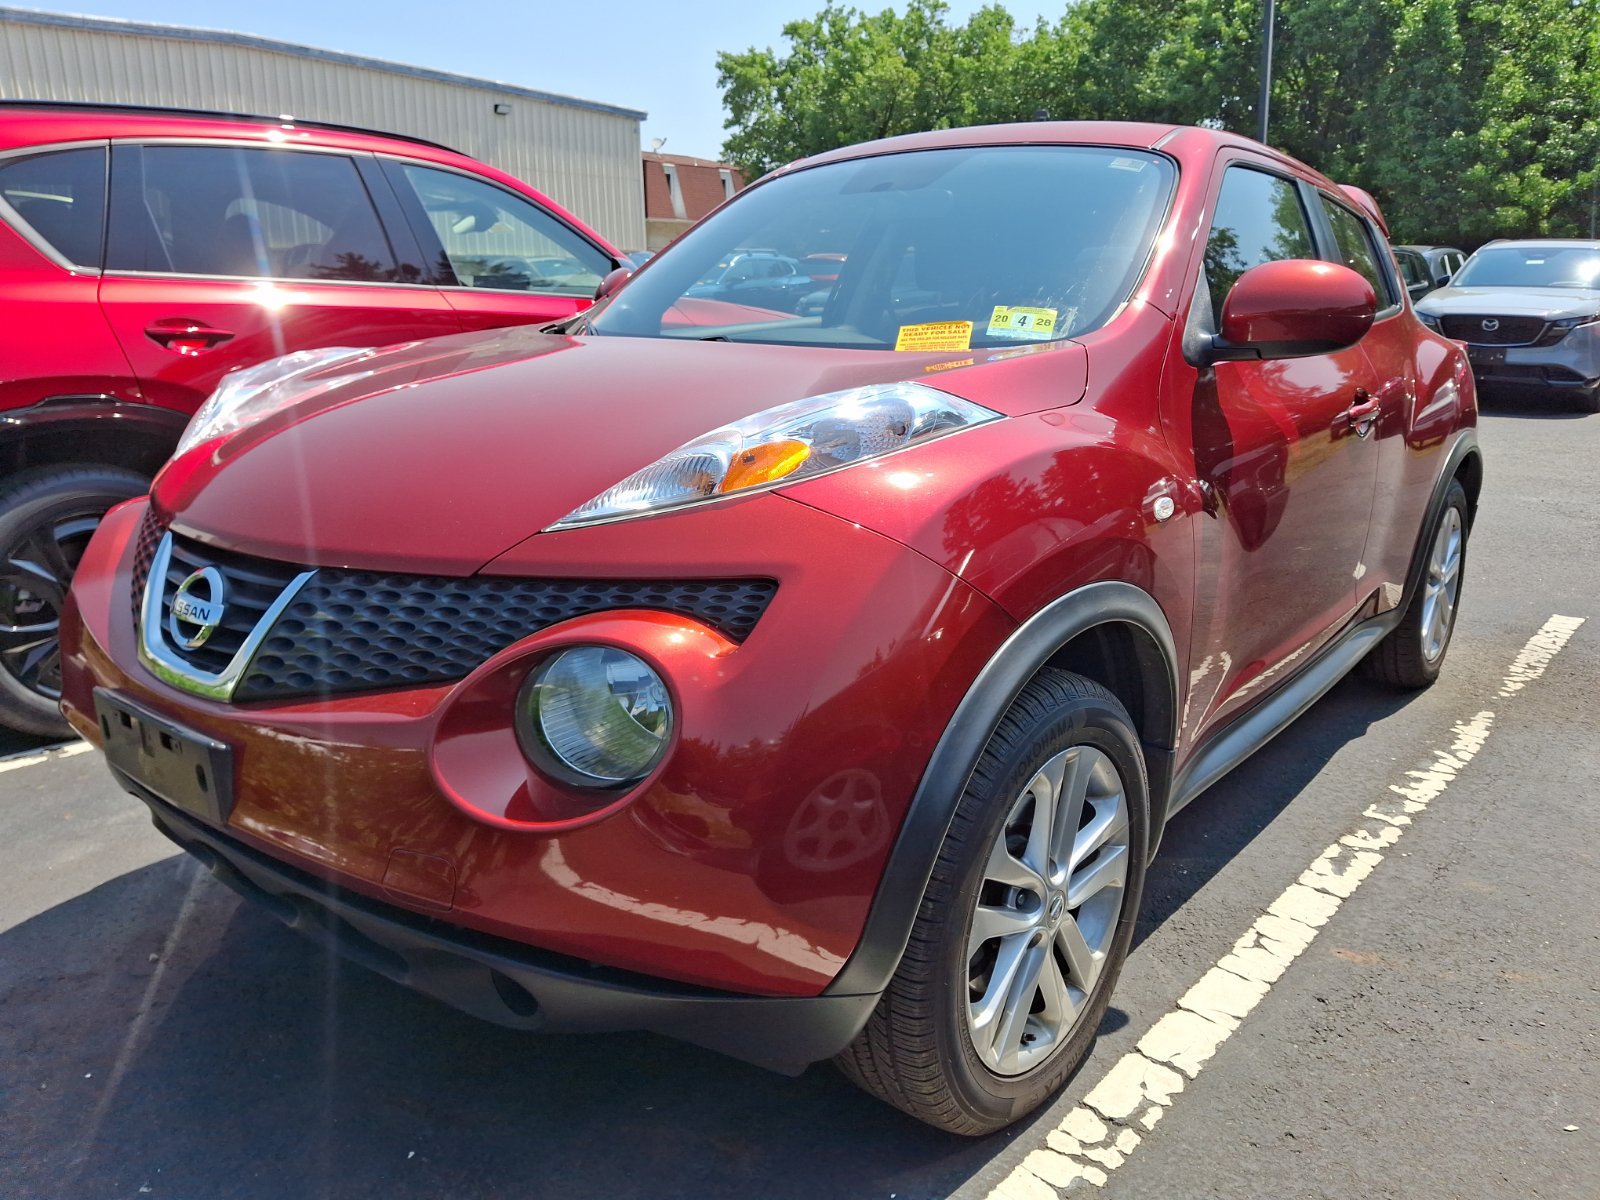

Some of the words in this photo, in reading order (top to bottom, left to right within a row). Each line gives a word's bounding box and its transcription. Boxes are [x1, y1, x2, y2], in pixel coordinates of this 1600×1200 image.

[994, 314, 1009, 323] 20
[1018, 315, 1027, 327] 4
[1036, 318, 1052, 327] 28
[174, 599, 211, 621] SSAN
[1010, 715, 1075, 785] YOKOHAMA
